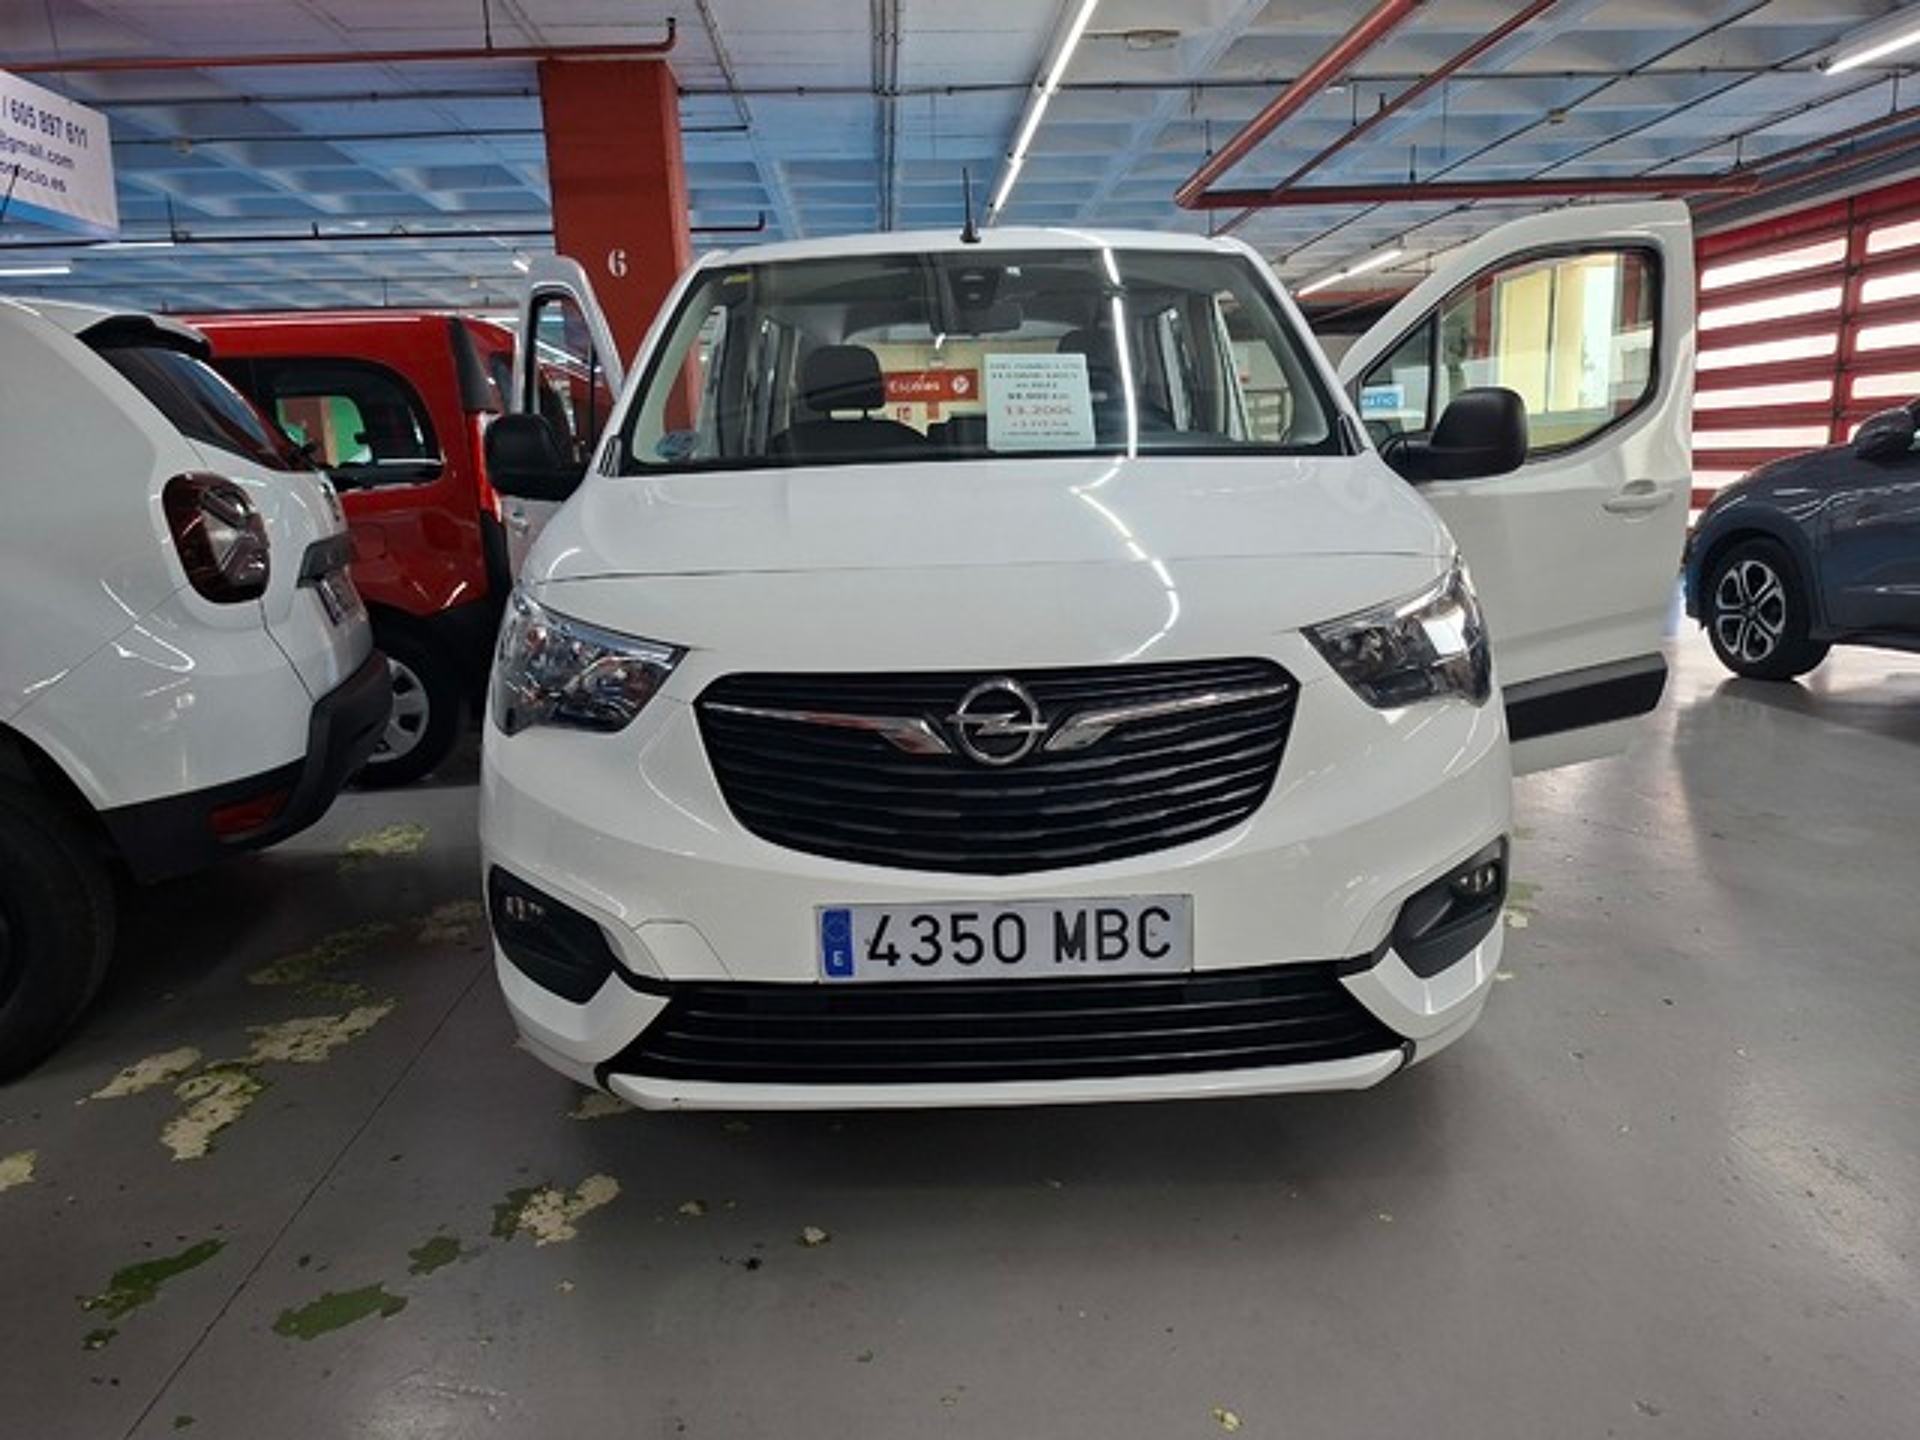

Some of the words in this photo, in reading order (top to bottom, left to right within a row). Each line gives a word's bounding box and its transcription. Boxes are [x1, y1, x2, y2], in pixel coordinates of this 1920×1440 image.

[11, 98, 37, 130] 605
[38, 110, 63, 139] 897
[65, 121, 88, 149] 611
[608, 249, 628, 277] 6
[866, 911, 1027, 967] 4350
[1053, 906, 1172, 963] MBC
[833, 950, 844, 967] E
